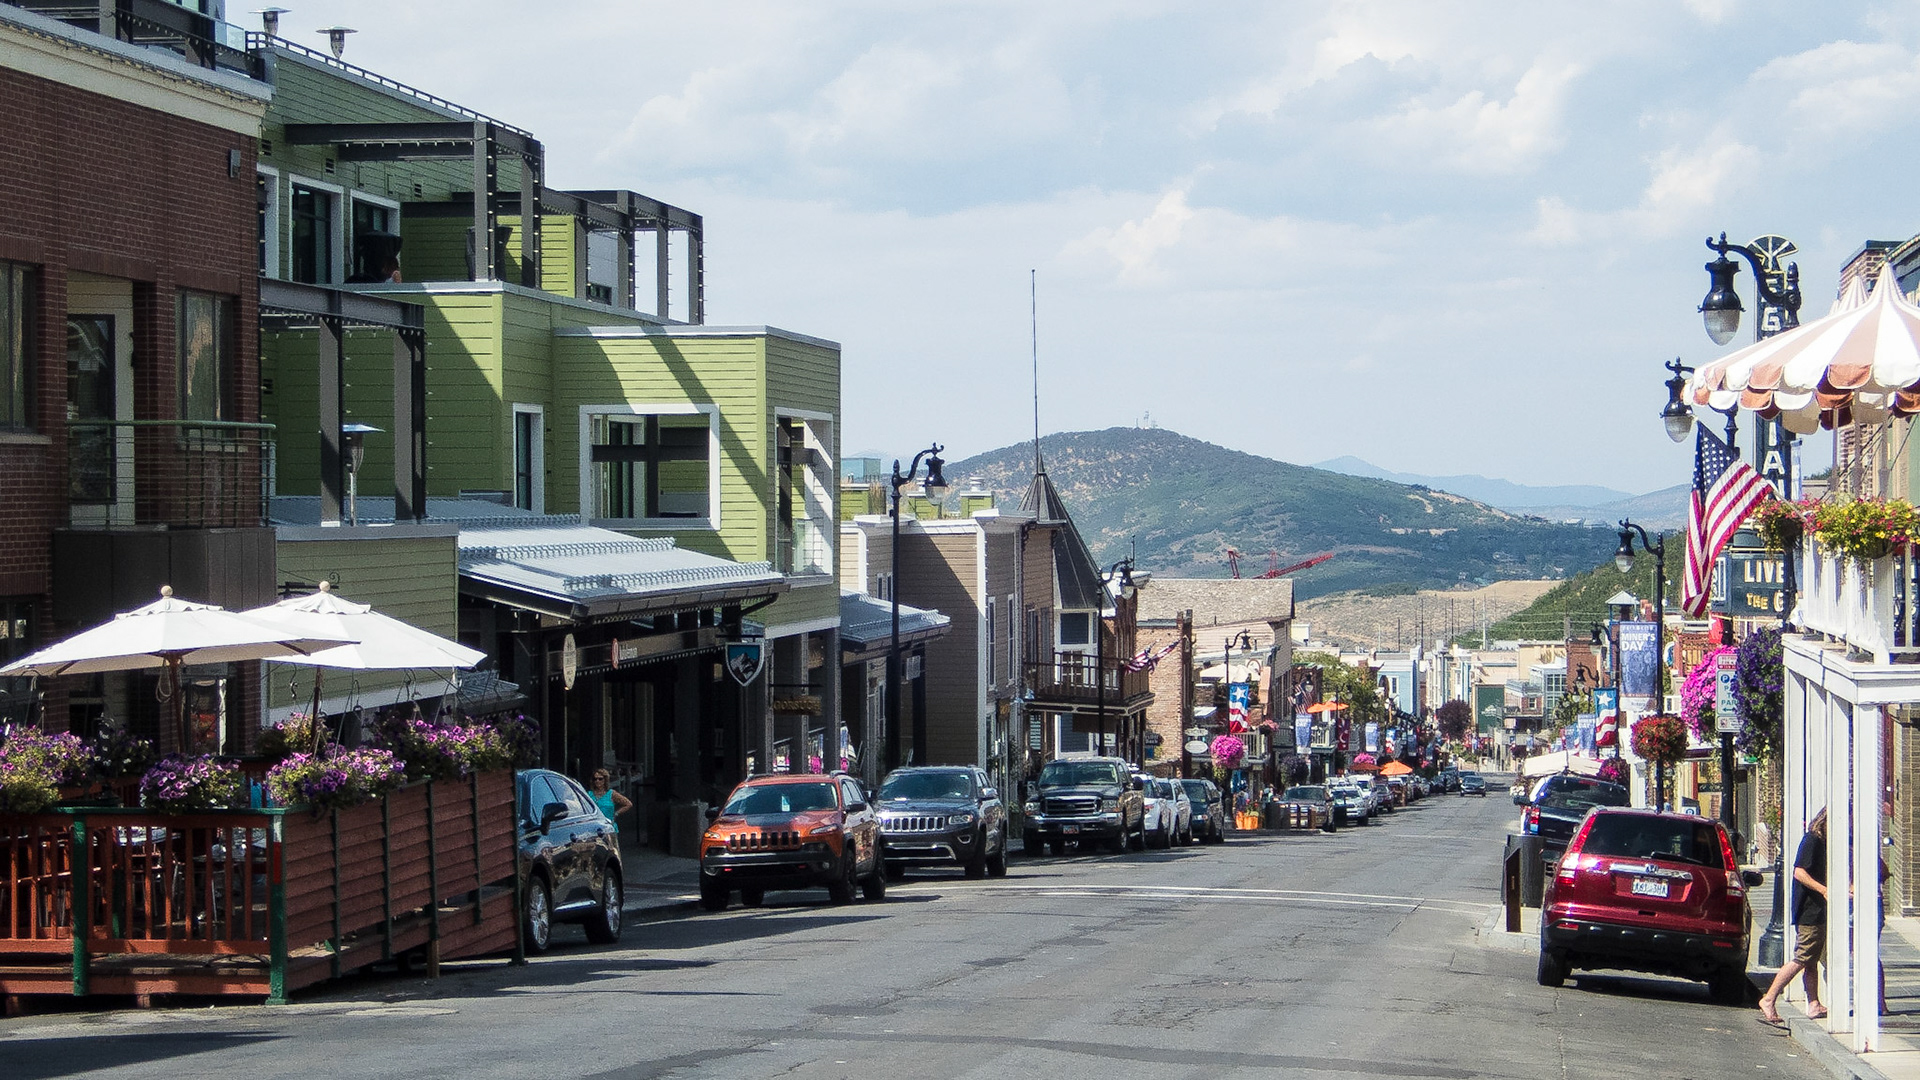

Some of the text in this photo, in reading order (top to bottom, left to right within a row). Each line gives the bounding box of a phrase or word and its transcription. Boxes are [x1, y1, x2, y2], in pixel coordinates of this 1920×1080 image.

[1744, 560, 1784, 583] LIVE
[1746, 592, 1769, 610] THE
[1621, 632, 1656, 642] MINER'S
[1621, 641, 1645, 651] DAY
